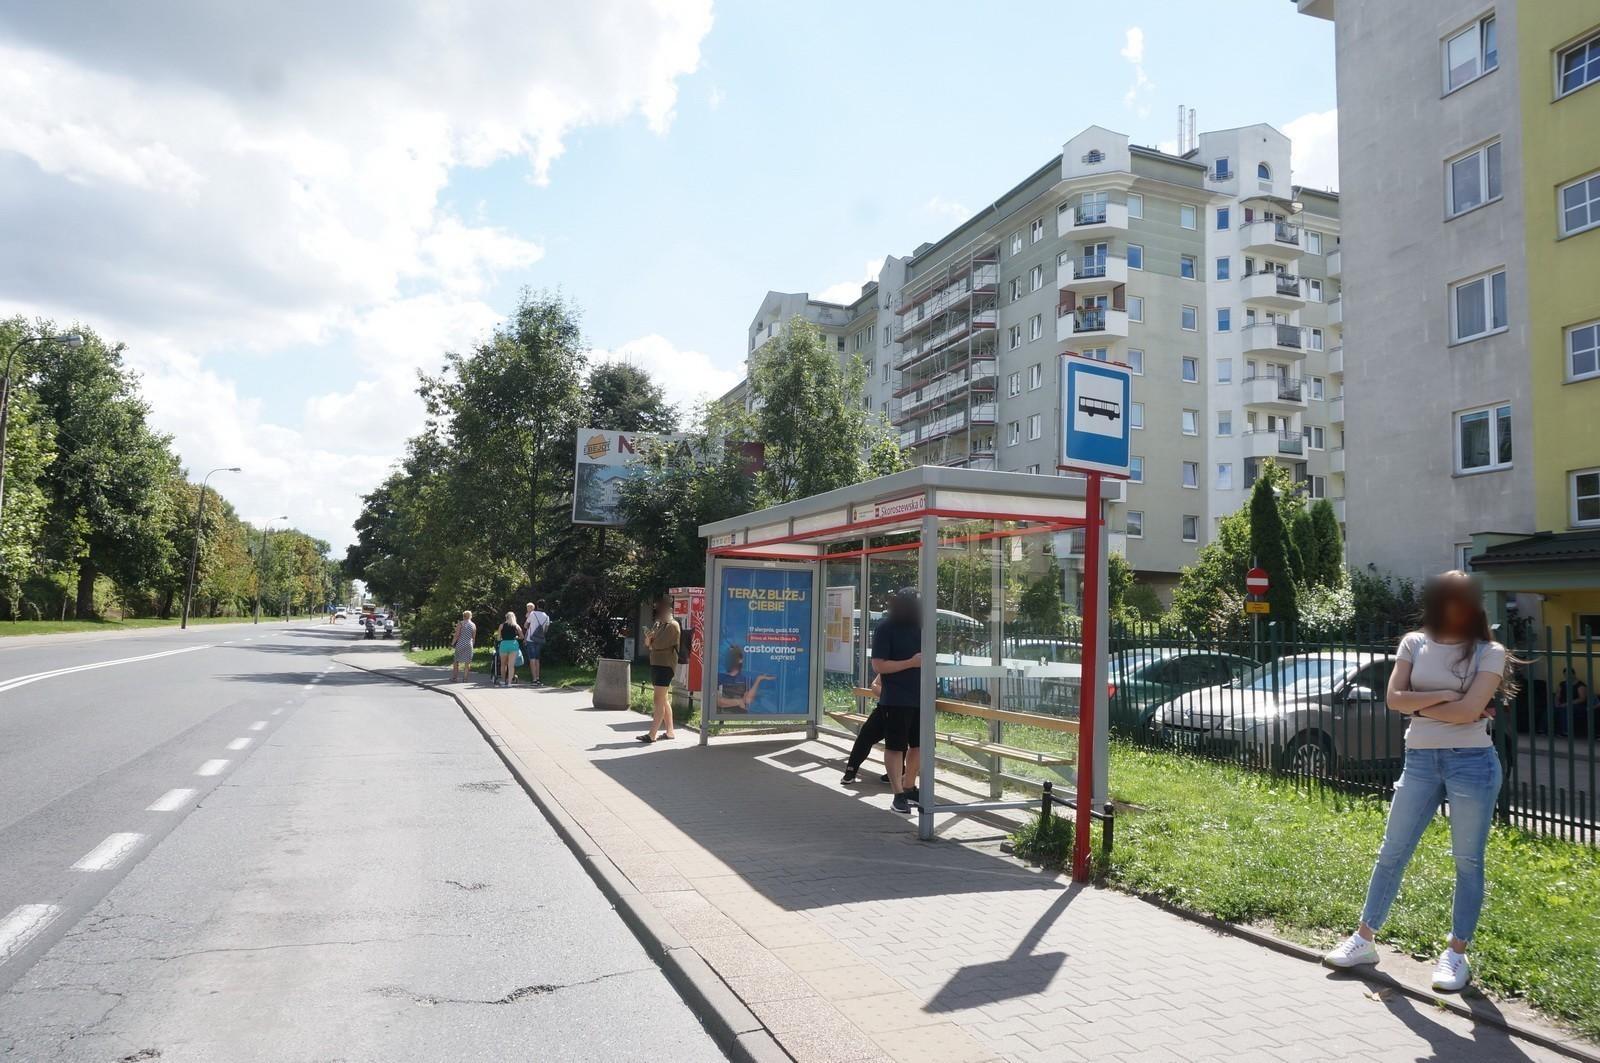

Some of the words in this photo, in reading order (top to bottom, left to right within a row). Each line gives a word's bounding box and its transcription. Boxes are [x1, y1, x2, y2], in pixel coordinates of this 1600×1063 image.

[881, 499, 919, 516] Skoroszewska
[728, 587, 766, 599] TERAZ
[767, 587, 806, 601] BLIŻEJ
[748, 600, 785, 611] CIEBIE
[743, 645, 797, 654] castorama
[770, 654, 796, 662] express
